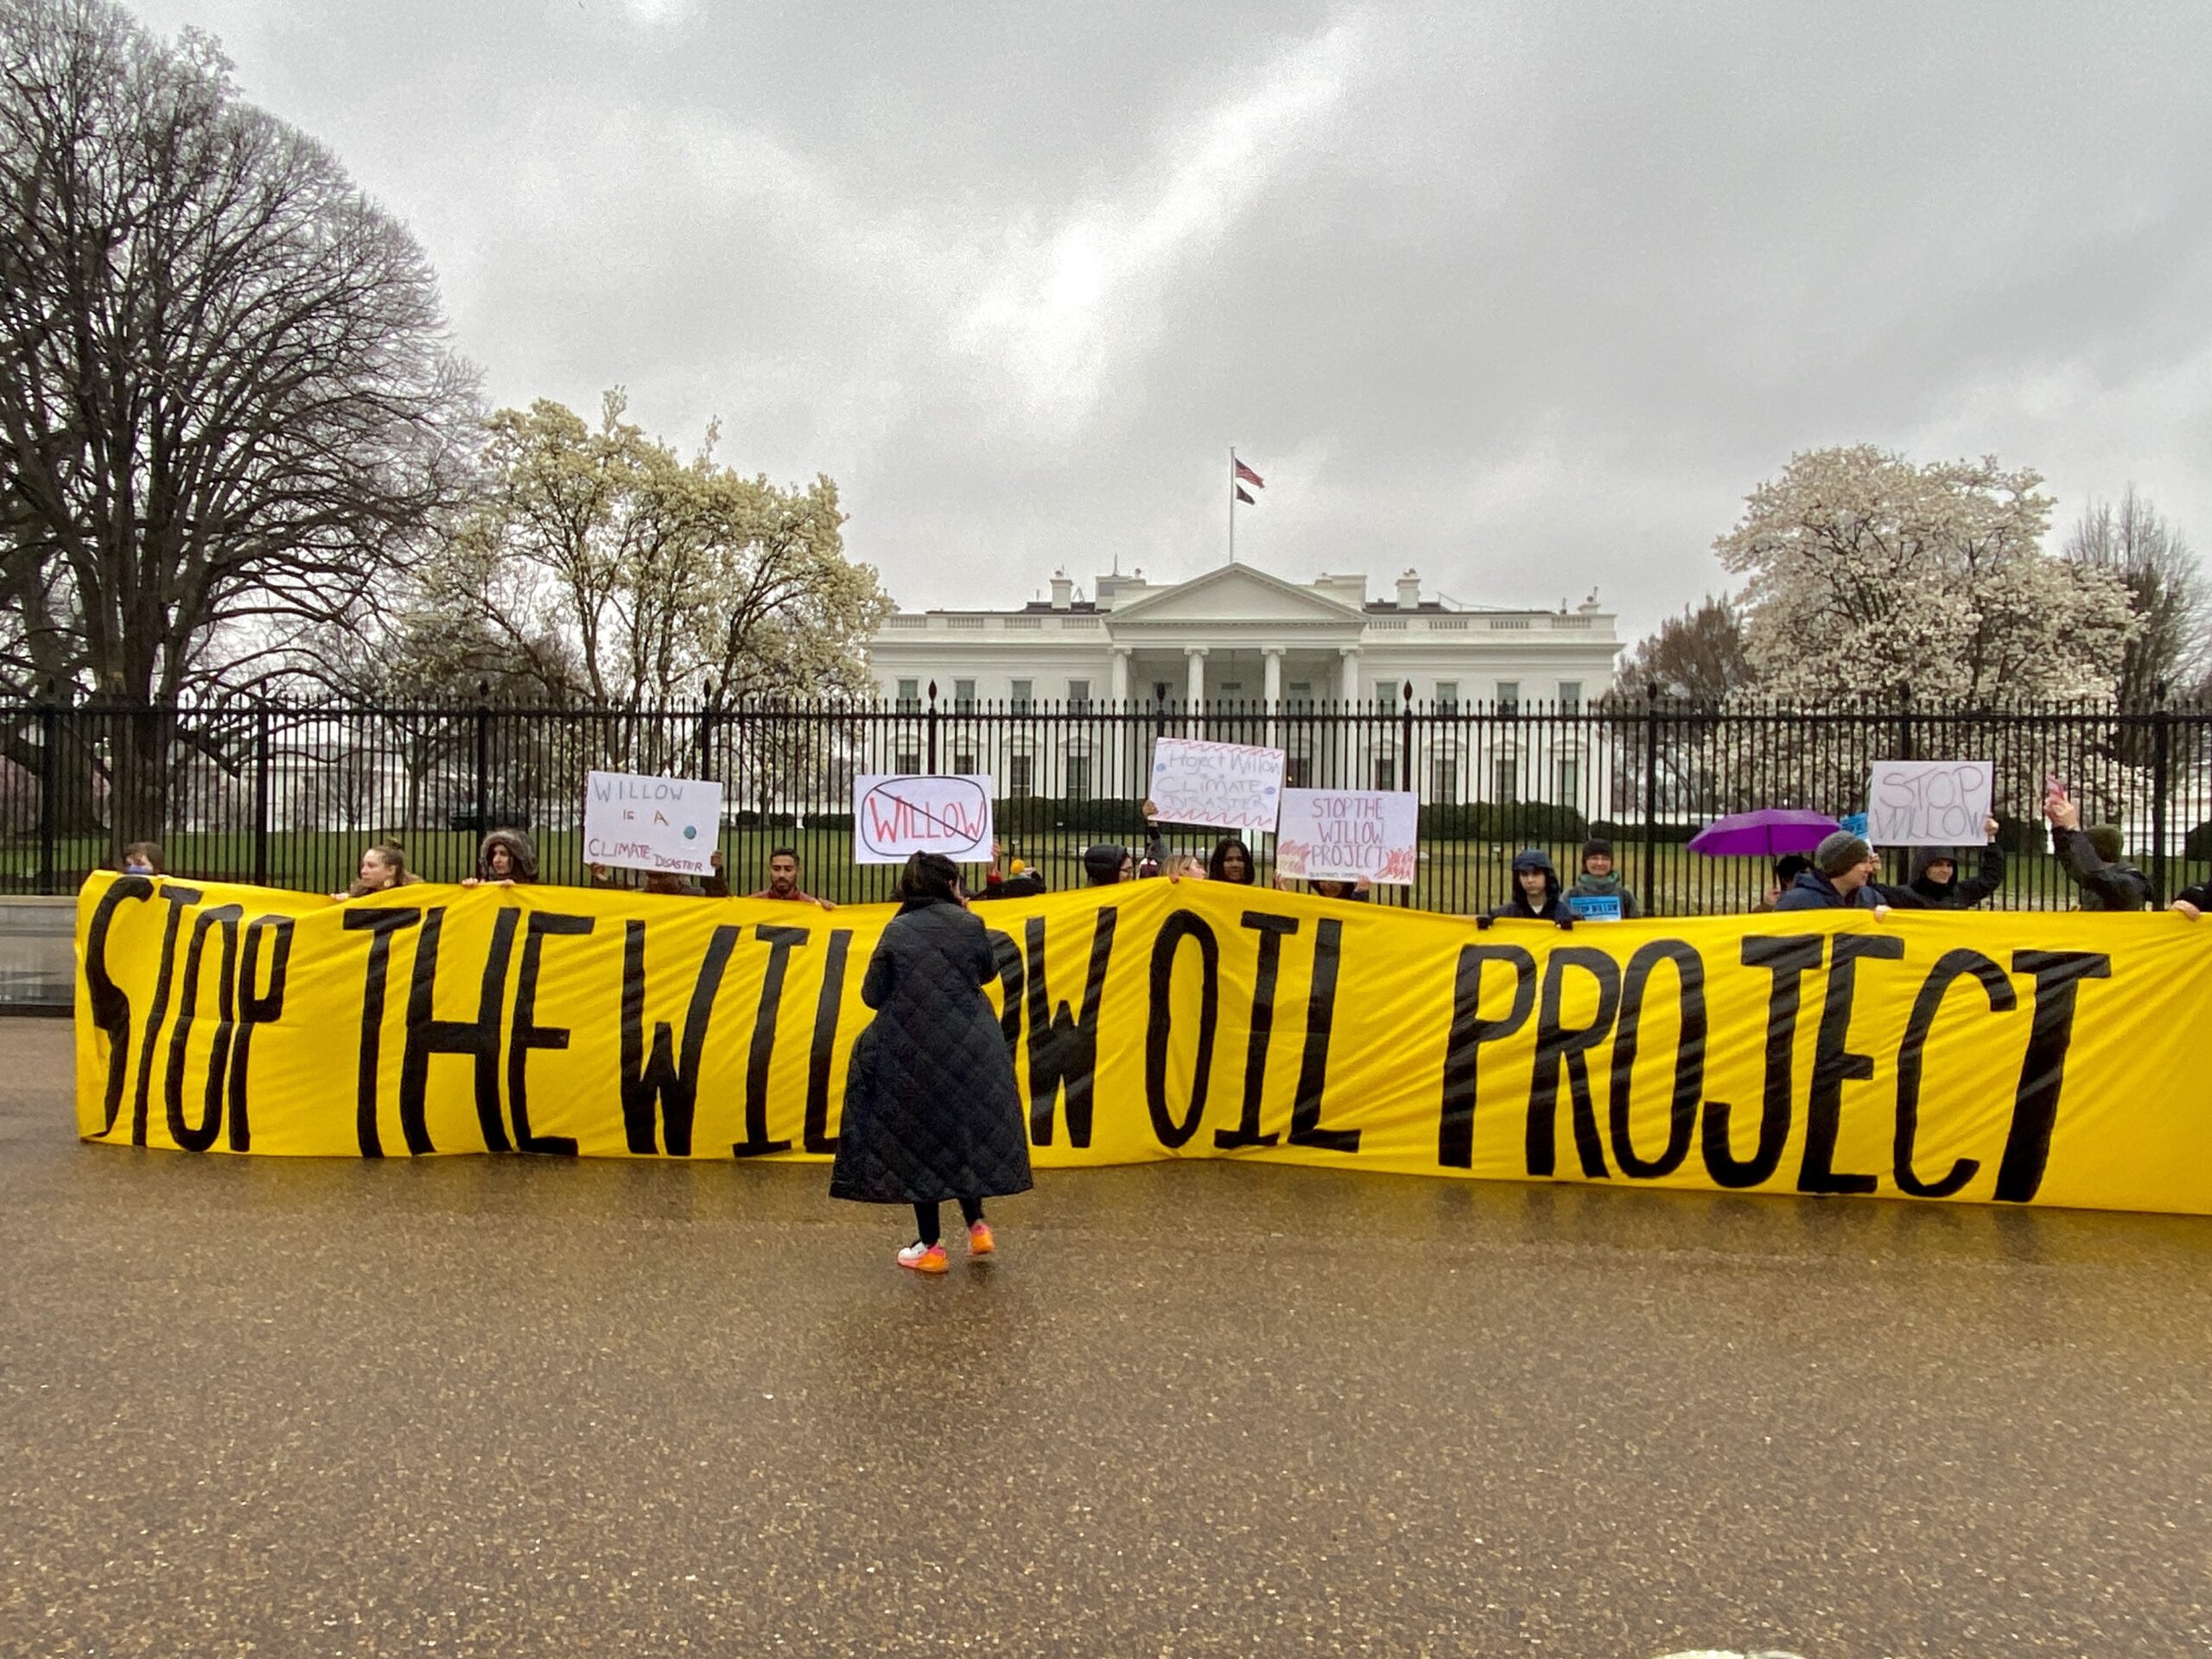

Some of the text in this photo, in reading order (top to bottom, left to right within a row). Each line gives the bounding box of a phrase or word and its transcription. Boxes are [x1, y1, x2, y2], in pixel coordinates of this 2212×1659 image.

[593, 777, 683, 803] WILLOW
[1878, 765, 1983, 810] STOP
[1161, 794, 1268, 811] DISASTER
[1312, 798, 1384, 819] STOP THE
[623, 809, 669, 826] IS A
[869, 796, 984, 843] WILLOW
[1873, 804, 1986, 841] WILLOW
[1318, 821, 1384, 844] WILLOW
[588, 838, 703, 872] CLIMATE DISASTER
[1311, 844, 1385, 869] PROJECT
[86, 875, 2111, 1202] STOP THE WILW OIL PROJECT
